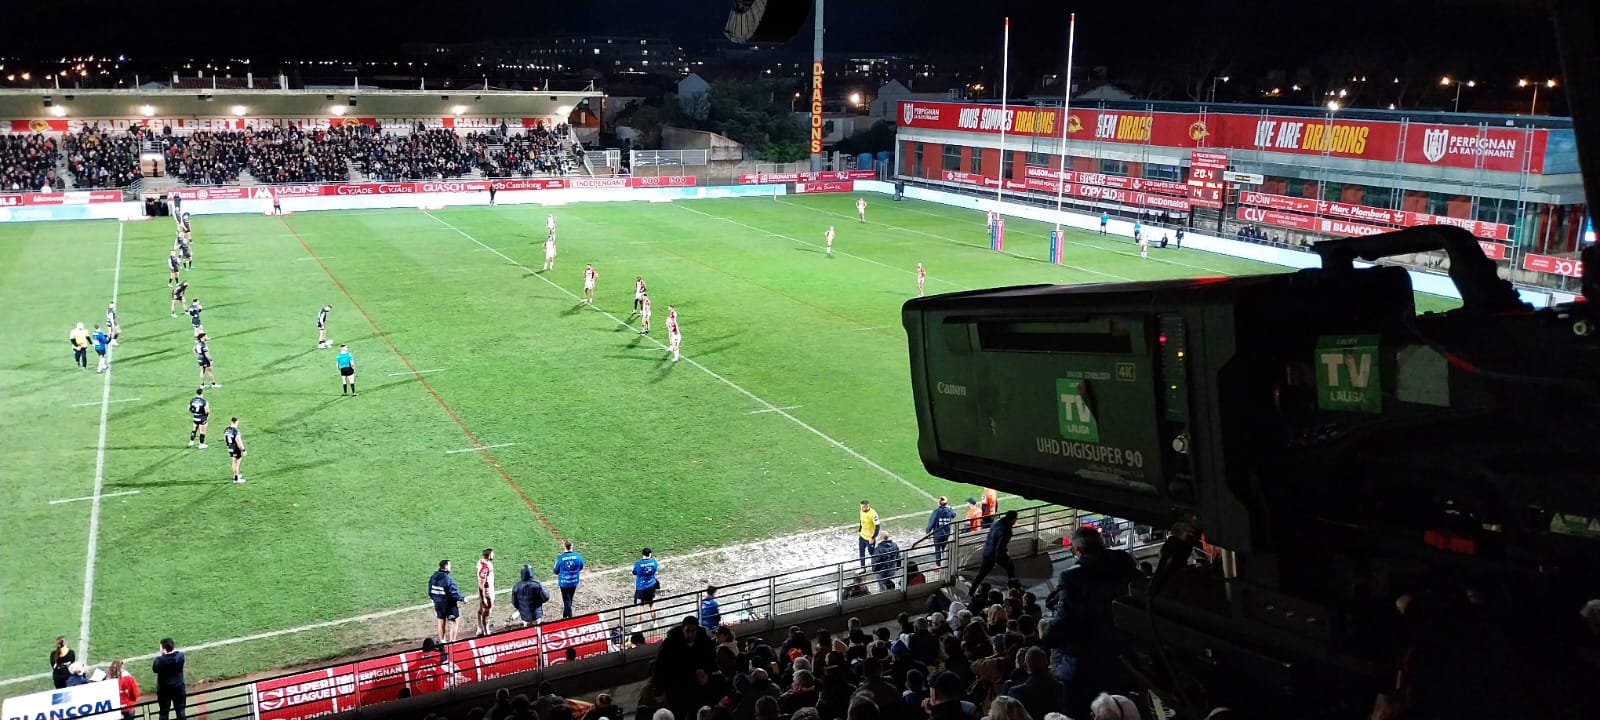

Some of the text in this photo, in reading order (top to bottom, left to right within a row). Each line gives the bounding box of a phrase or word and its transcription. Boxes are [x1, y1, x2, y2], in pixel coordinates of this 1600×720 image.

[811, 62, 823, 153] DRAGONS
[957, 107, 1056, 134] NOUS SOMMES DRAGONS
[1095, 115, 1118, 139] SEM
[1254, 121, 1369, 155] WE ARE DRAGONS
[423, 183, 464, 192] GUASCH
[1147, 196, 1189, 209] McDonald's
[1244, 208, 1266, 222] CLV
[1330, 204, 1391, 220] Marc Plomberie
[1120, 365, 1133, 378] 4K
[1320, 353, 1371, 388] TV
[937, 381, 967, 396] Canon
[1061, 394, 1090, 423] TV
[1037, 437, 1143, 468] UHD DIGISUPER 90
[569, 633, 606, 647] LEAGUE
[570, 625, 602, 639] SUPER
[286, 680, 329, 696] SUPER
[287, 689, 331, 706] LEAGUE
[9, 699, 113, 720] ANCOM
